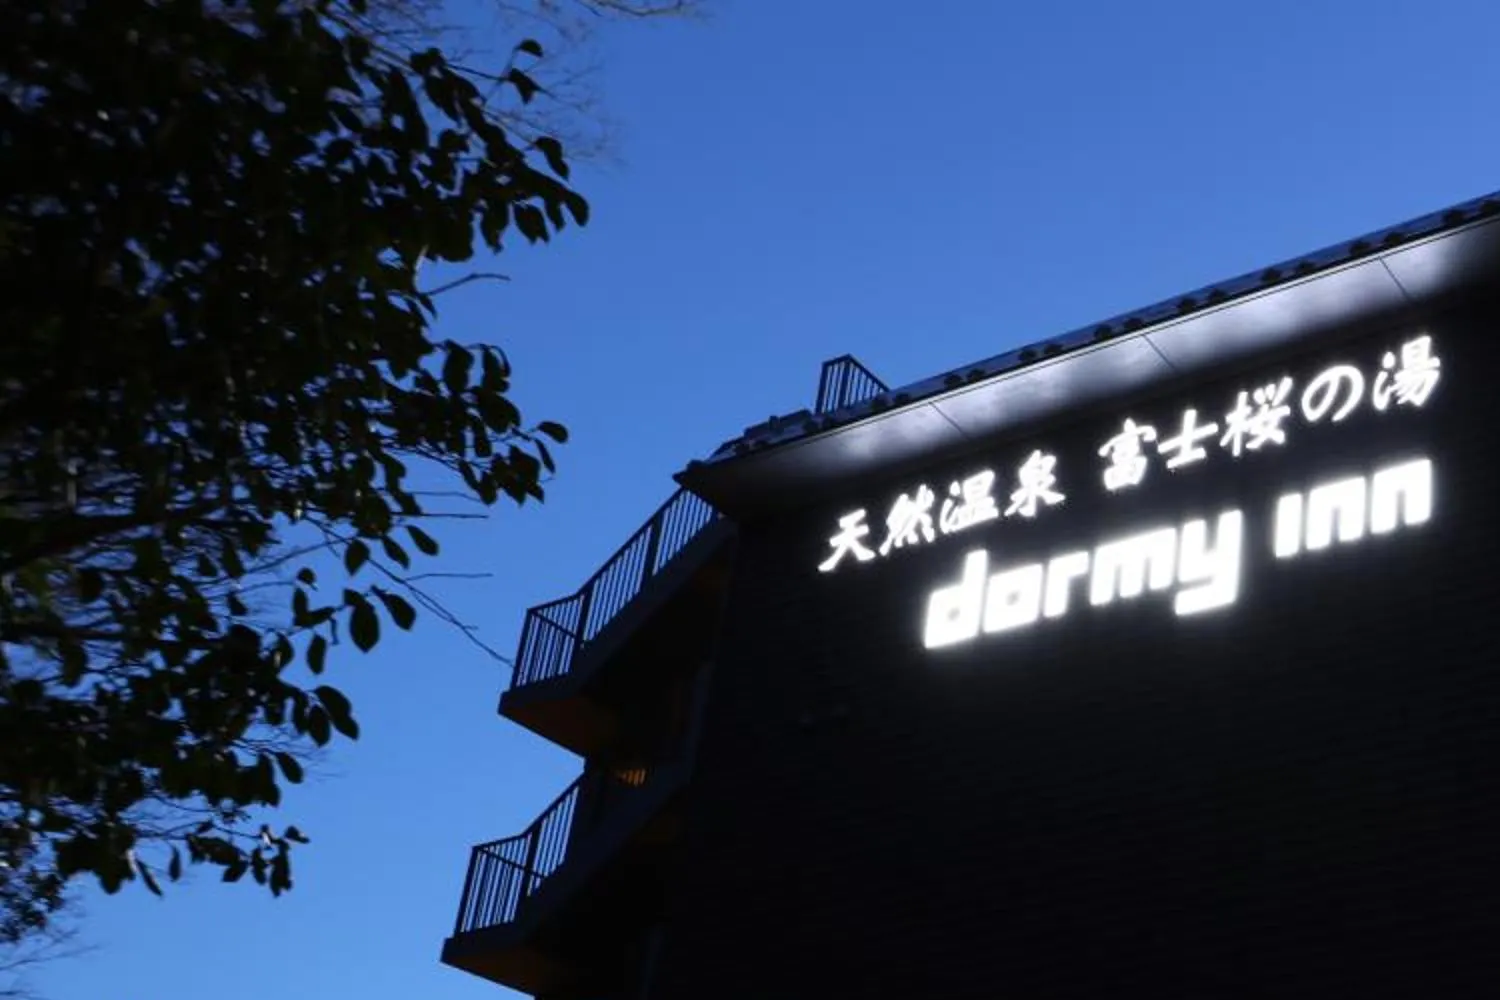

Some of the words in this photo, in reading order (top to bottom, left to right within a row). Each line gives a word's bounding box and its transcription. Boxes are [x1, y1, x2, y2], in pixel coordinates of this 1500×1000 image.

[818, 447, 1066, 572] 天然温泉
[1098, 335, 1442, 493] 富士桜の湯
[923, 509, 1244, 649] dormy
[1275, 457, 1434, 558] inn
